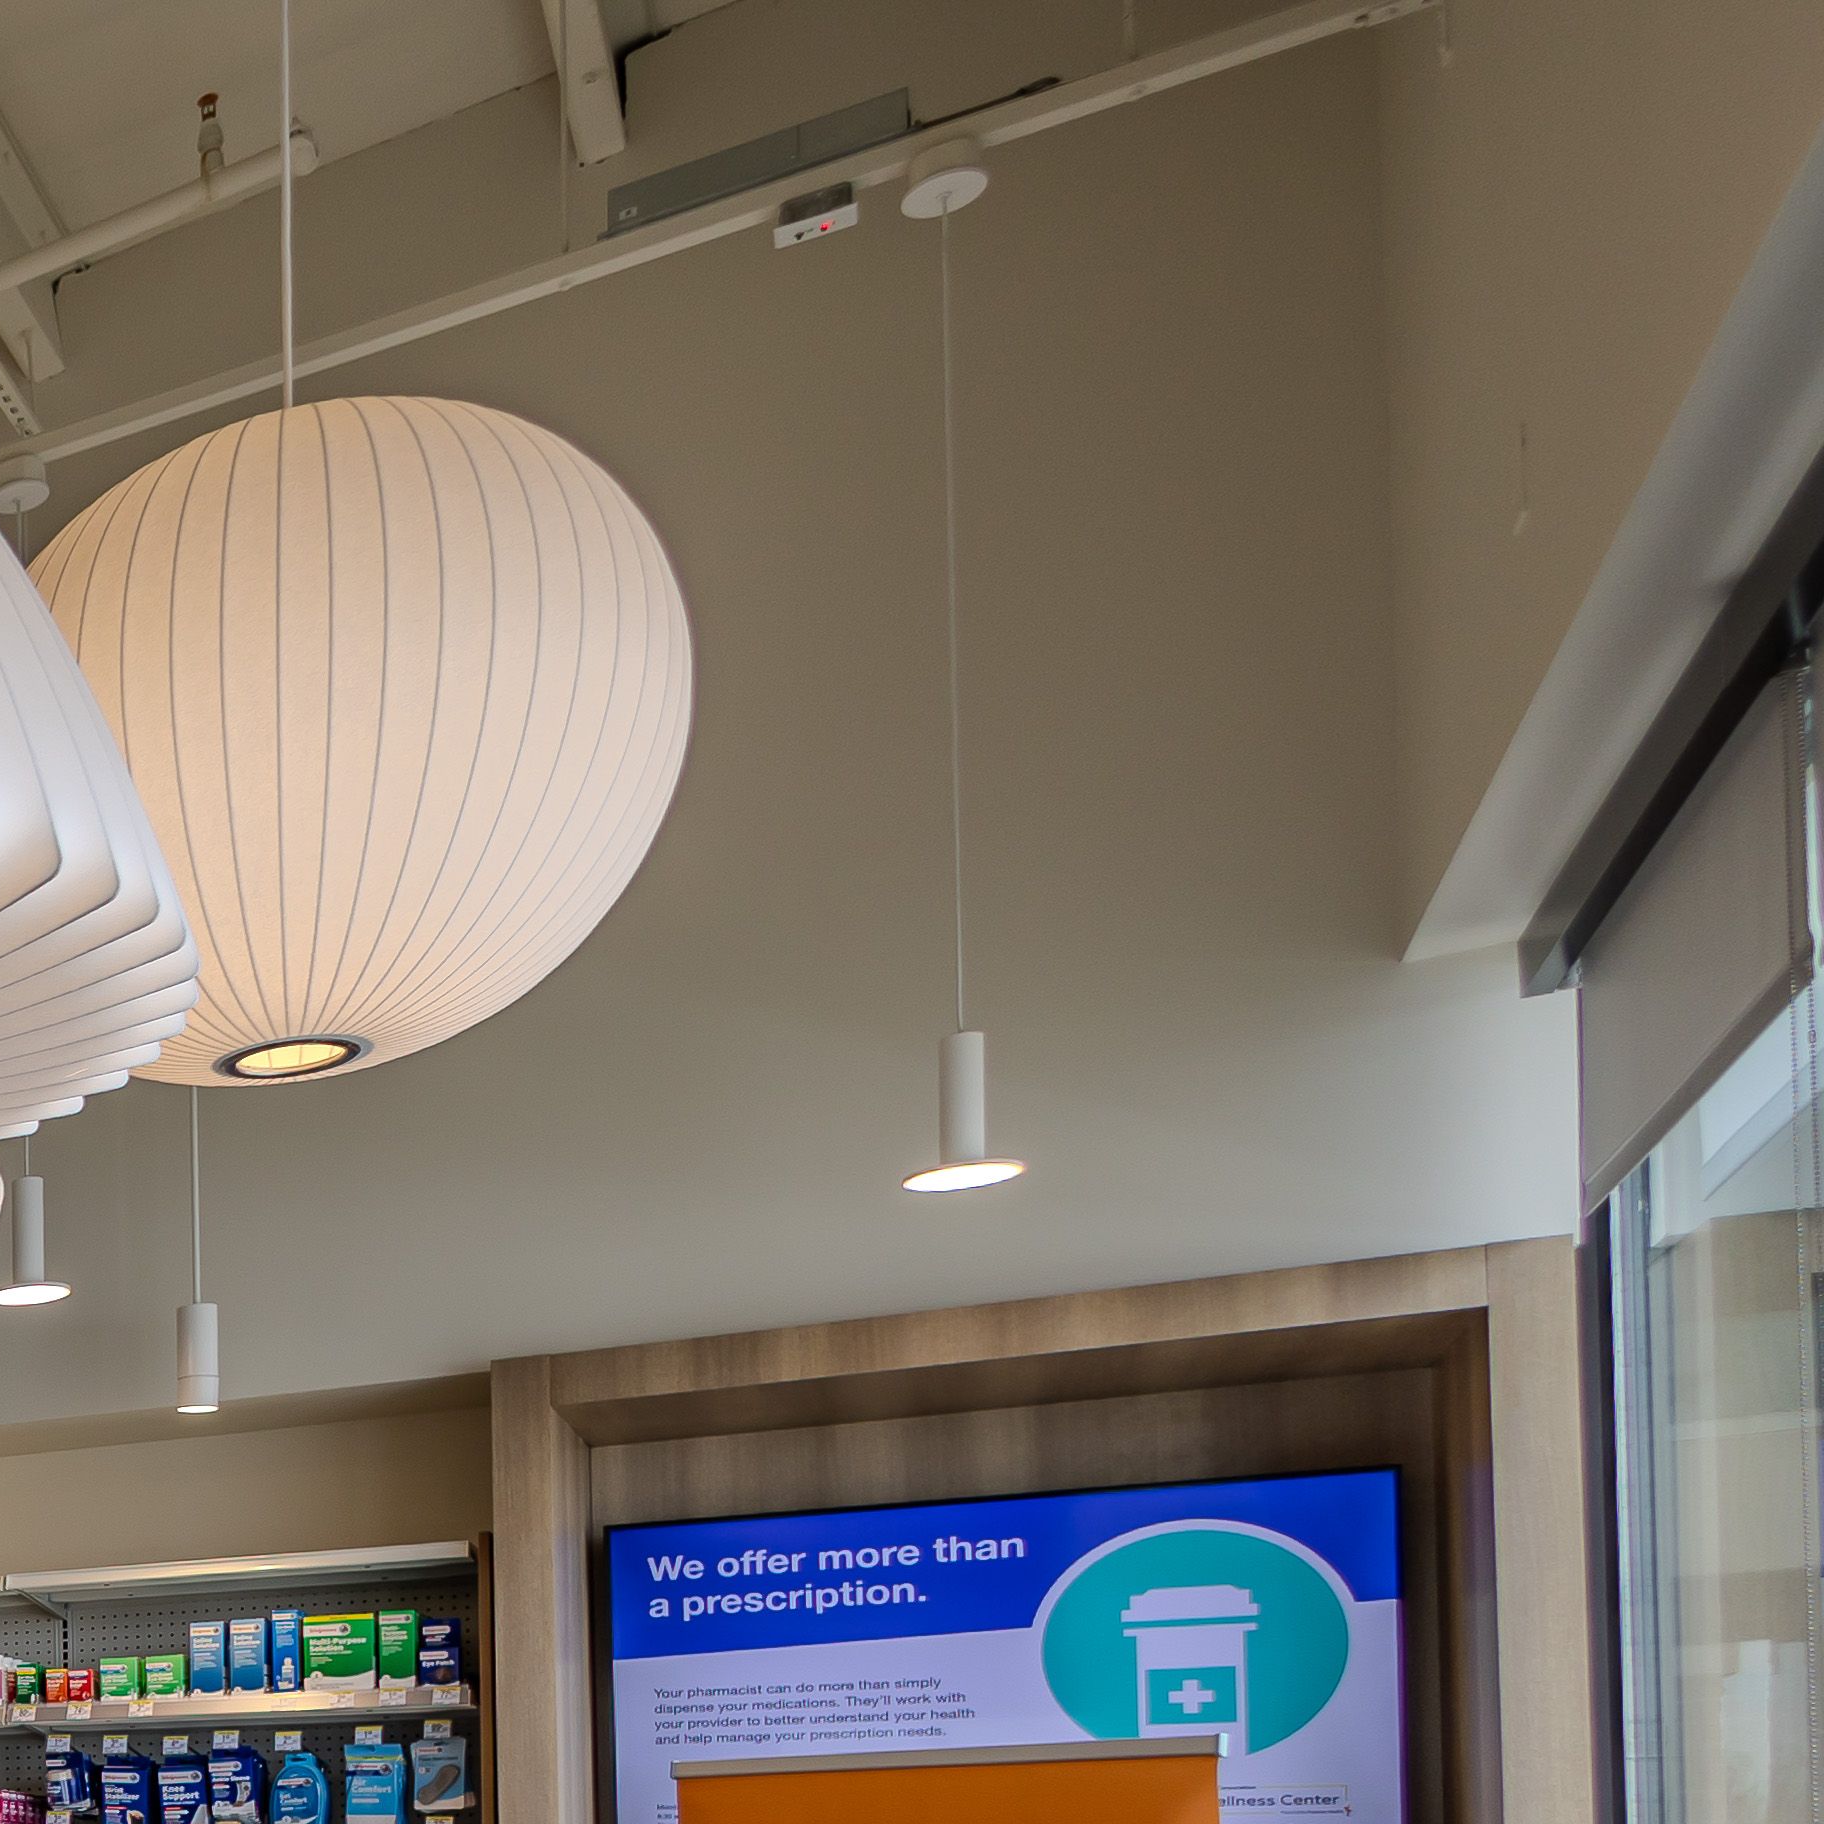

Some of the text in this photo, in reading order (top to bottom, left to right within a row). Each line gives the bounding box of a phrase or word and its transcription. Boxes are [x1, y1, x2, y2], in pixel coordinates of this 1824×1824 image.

[647, 1536, 1025, 1582] We offer more than
[649, 1579, 927, 1622] a prescription.
[654, 1677, 942, 1699] Your pharmacist can do more than simply
[654, 1693, 966, 1716] dispense your medications. They'll work with
[654, 1708, 975, 1730] your provider to better understand your health
[655, 1726, 947, 1745] and help manage your prescription needs.
[162, 1785, 184, 1793] Knee
[162, 1791, 200, 1800] Support
[1280, 1794, 1340, 1806] Center
